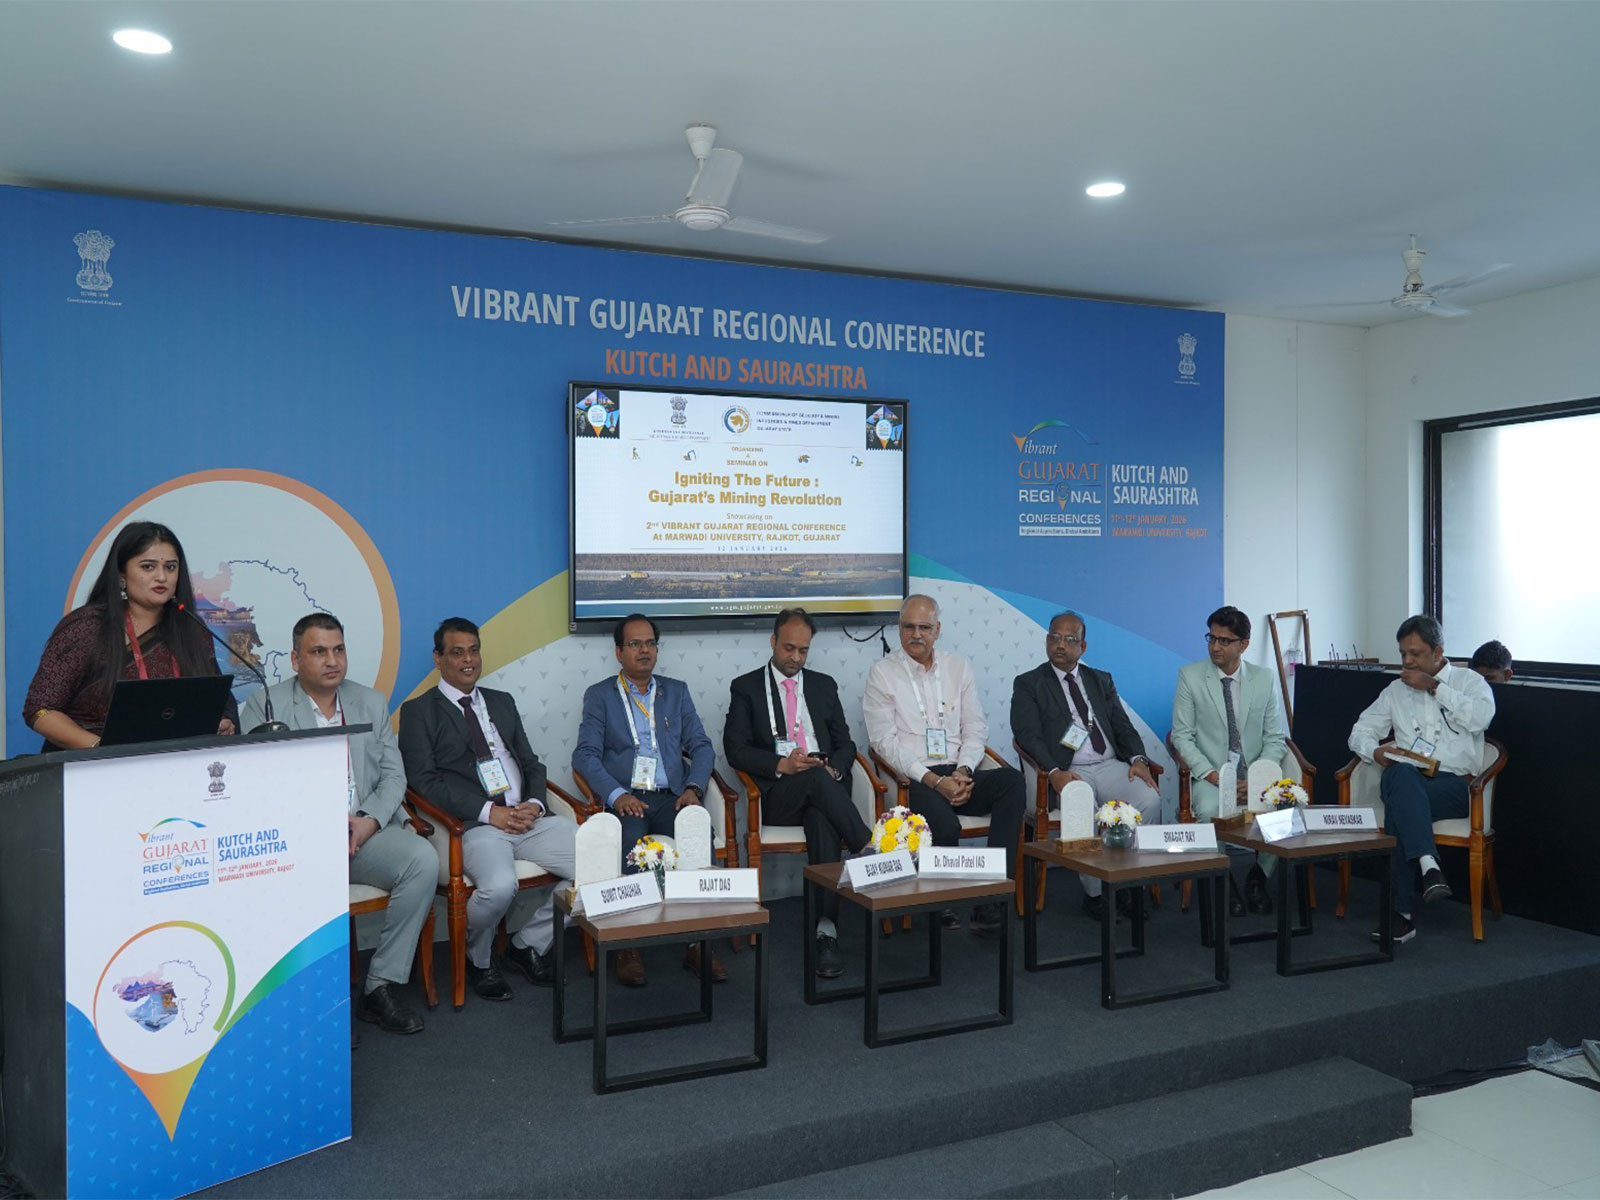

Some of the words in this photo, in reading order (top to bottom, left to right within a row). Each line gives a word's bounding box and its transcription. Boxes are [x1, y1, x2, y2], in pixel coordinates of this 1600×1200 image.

[451, 285, 580, 326] VIBRANT
[589, 298, 704, 339] GUJARAT
[713, 308, 837, 346] REGIONAL
[844, 320, 985, 358] CONFERENCE
[605, 349, 676, 378] KUTCH
[684, 354, 731, 381] AND
[738, 357, 867, 390] SAURASHTRA
[1011, 432, 1059, 455] Vibrant
[726, 459, 758, 467] SEMINAR
[1018, 460, 1101, 481] GUJARAT
[674, 471, 730, 488] Igniting
[734, 473, 762, 486] The
[765, 474, 811, 487] Future
[814, 478, 819, 487] :
[1111, 464, 1155, 484] KUTCH
[1159, 465, 1189, 485] AND
[719, 491, 766, 507] Mining
[770, 492, 842, 506] Revolution
[1113, 485, 1199, 505] SAURASHTRA
[726, 512, 764, 521] Showcasing
[1018, 513, 1102, 525] CONFERENCES
[661, 522, 701, 530] VIBRANT
[703, 523, 744, 531] GUJARAT
[746, 523, 789, 531] REGIONAL
[652, 533, 663, 541] At
[665, 533, 707, 541] MARWADI
[710, 533, 764, 542] UNIVERSITY,
[766, 534, 801, 542] RAJKOT,
[217, 832, 253, 849] KUTCH
[255, 828, 279, 843] AND
[143, 838, 209, 860] GUJARAT
[218, 840, 288, 862] SAURASHTRA
[934, 855, 942, 868] Dr.
[943, 855, 961, 868] Dhaval
[961, 855, 975, 868] Patel
[975, 855, 985, 868] IAS
[143, 870, 209, 888] CONFERENCES
[699, 878, 719, 892] RAJAT
[719, 877, 731, 891] DAS
